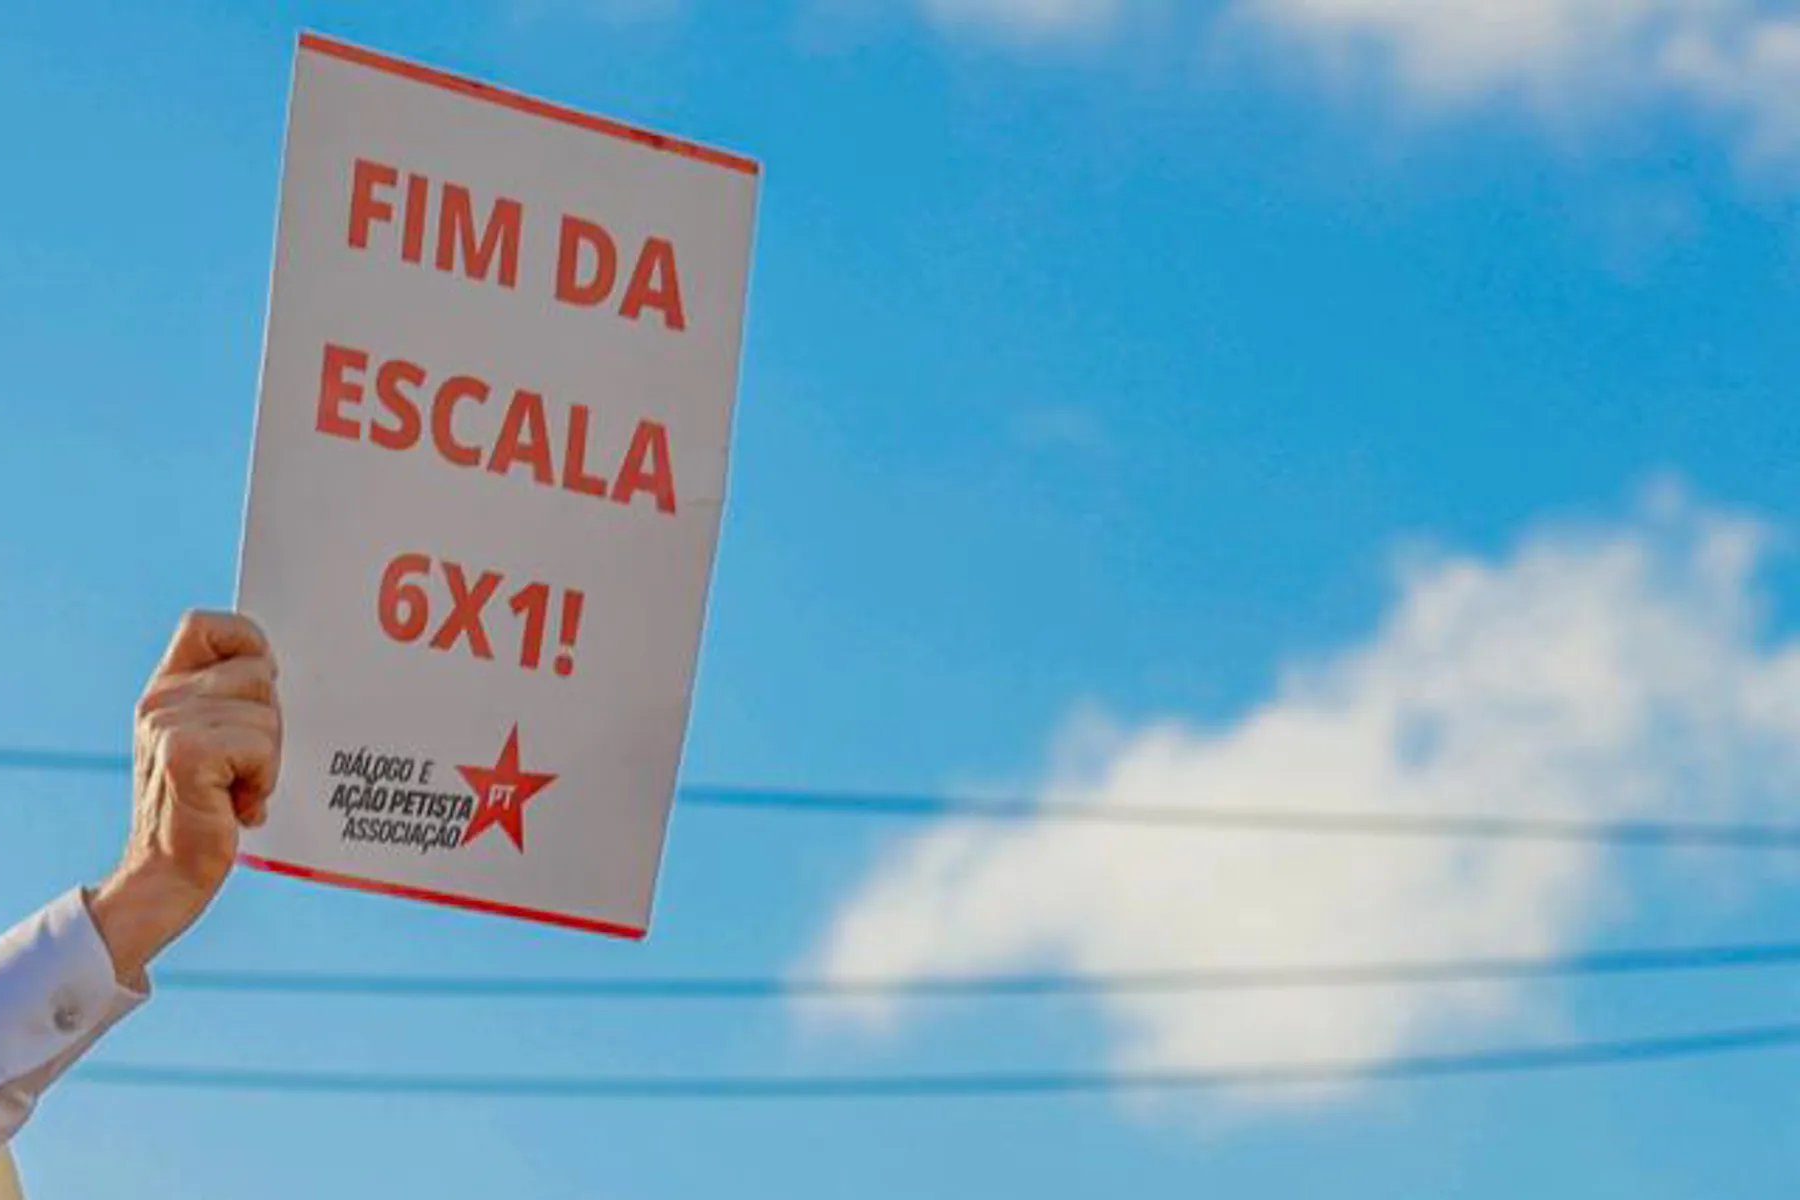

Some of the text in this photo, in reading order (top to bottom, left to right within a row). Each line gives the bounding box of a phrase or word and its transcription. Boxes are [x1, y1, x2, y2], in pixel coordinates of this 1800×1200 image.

[347, 157, 686, 331] FIM DA
[315, 343, 677, 515] ESCALA
[377, 553, 584, 678] 6X1!
[330, 748, 435, 785] DIÁLOGO E
[329, 784, 474, 820] AÇÃO PETISTA
[488, 784, 516, 810] PT
[342, 817, 463, 853] ASSOCIAÇÃO
